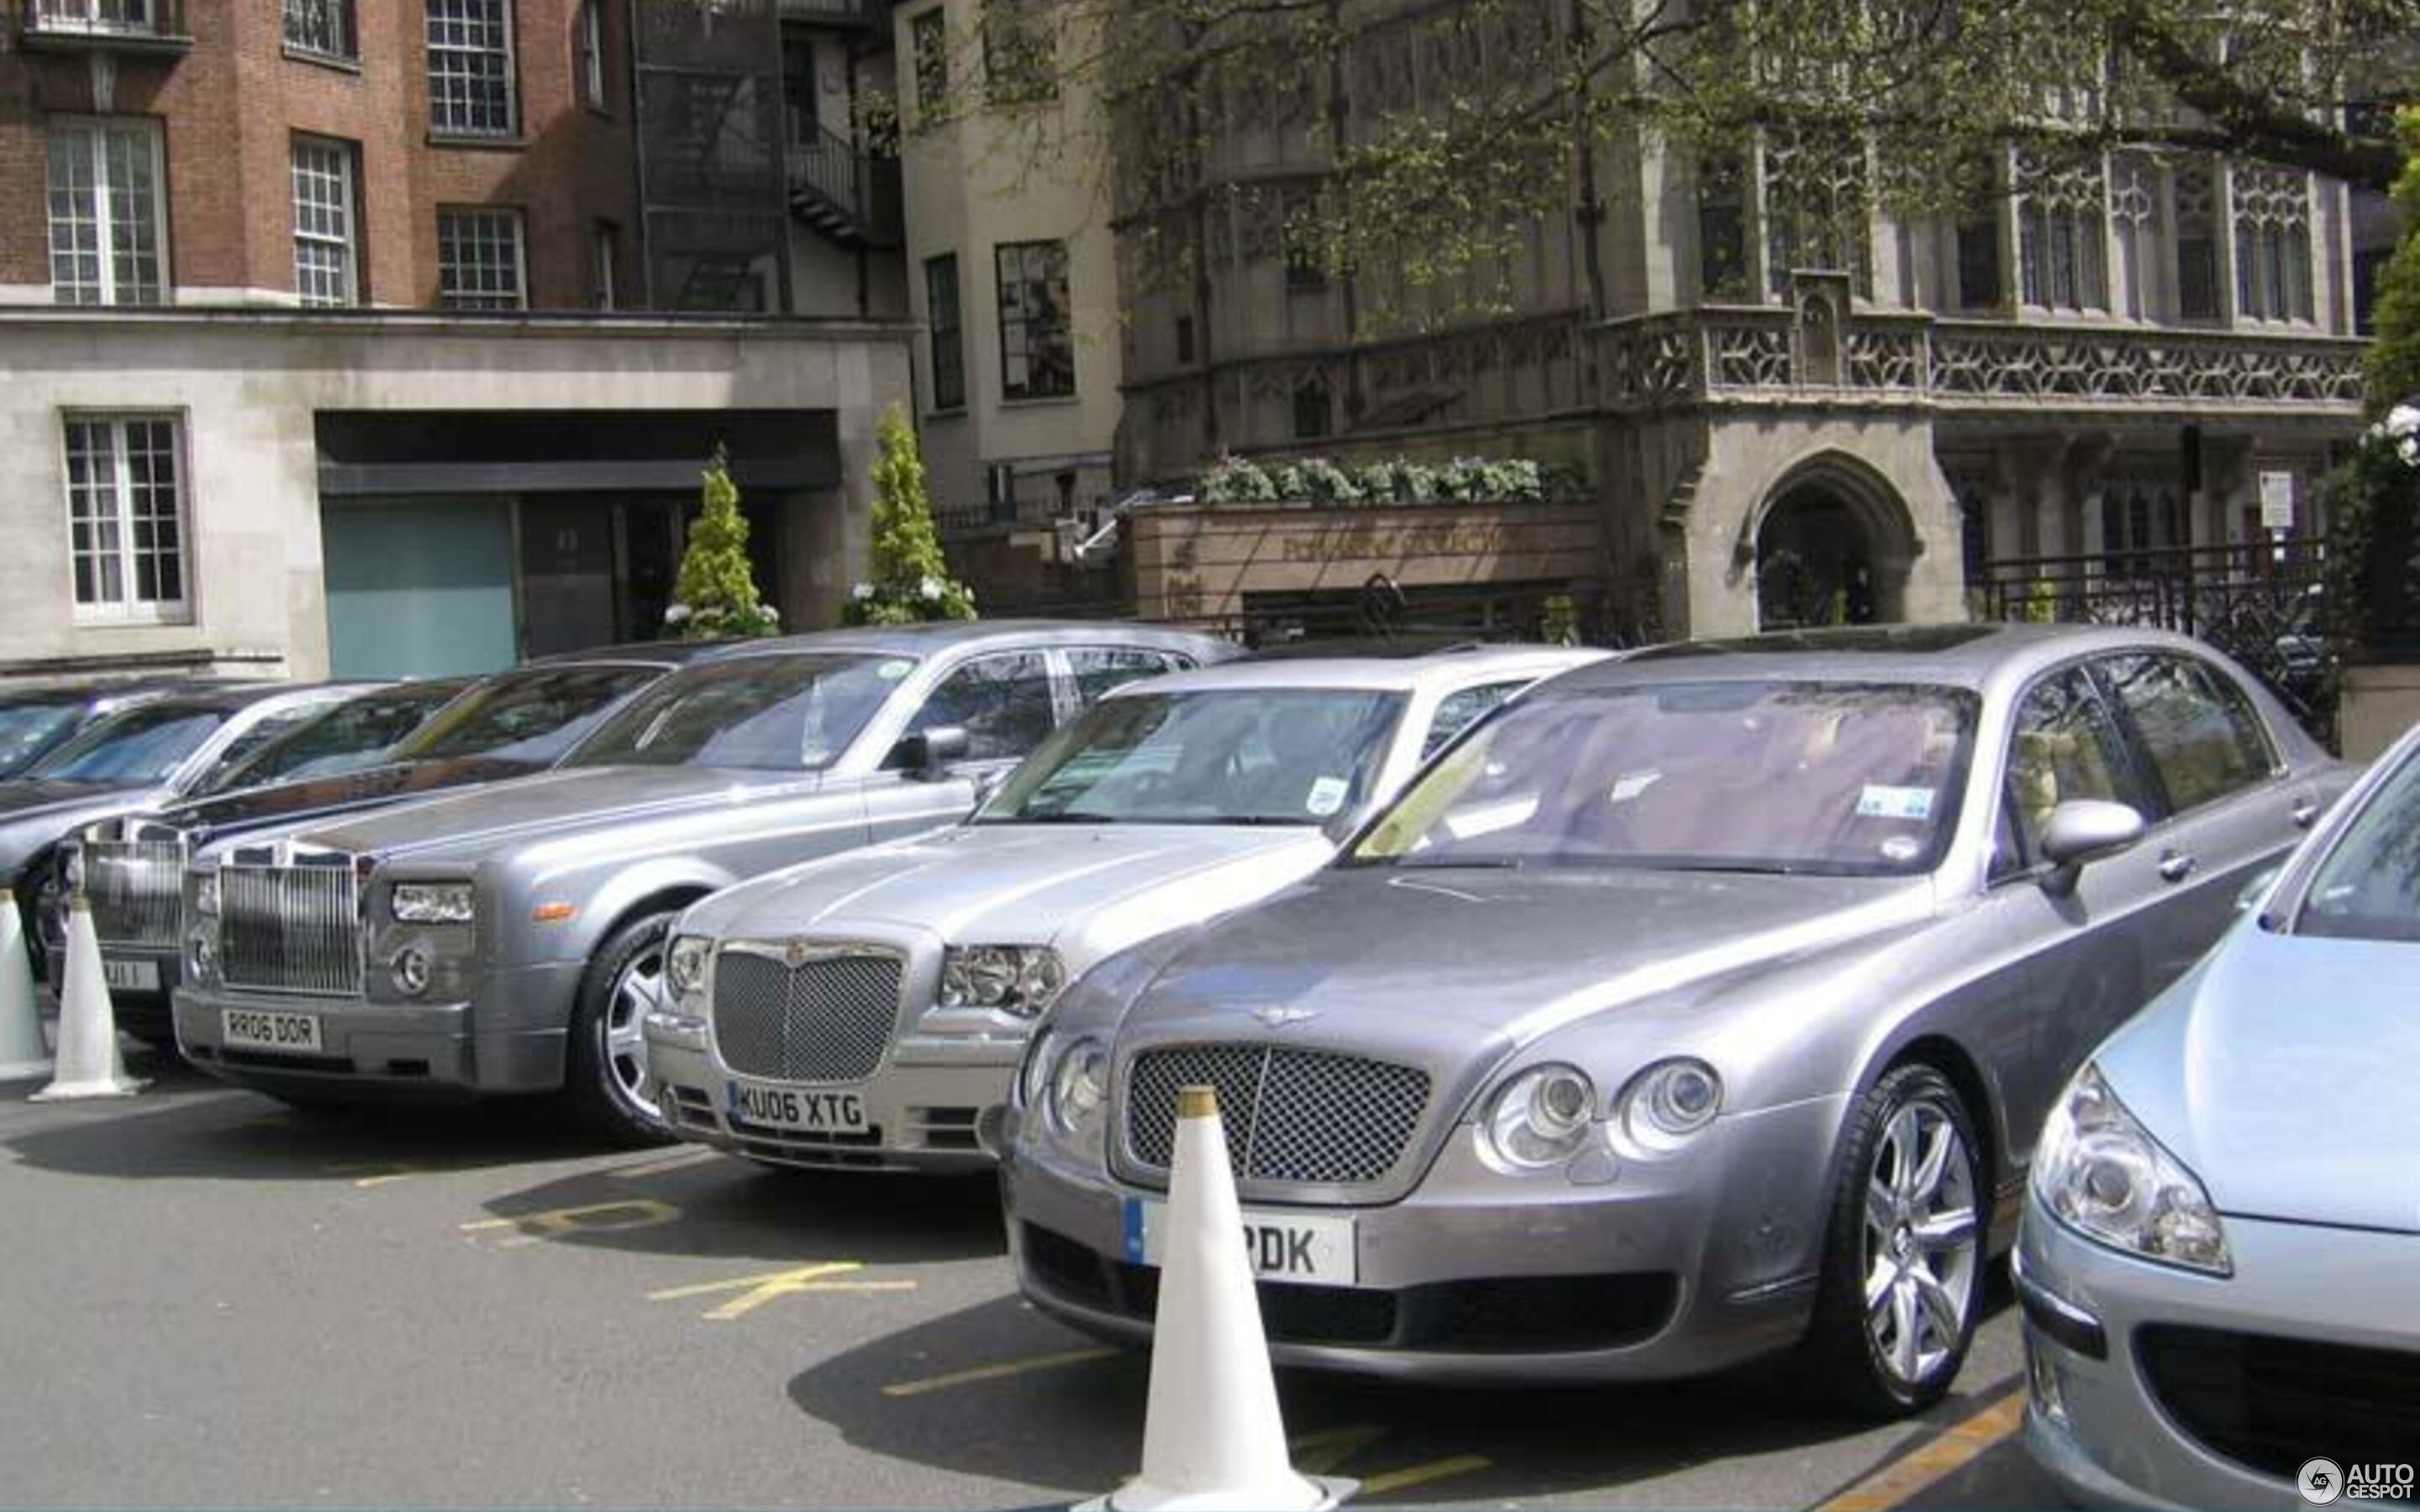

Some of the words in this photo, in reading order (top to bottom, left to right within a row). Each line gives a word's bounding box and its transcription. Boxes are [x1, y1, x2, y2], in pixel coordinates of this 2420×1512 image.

[229, 1013, 273, 1041] RR06
[276, 1015, 313, 1044] DOR
[740, 1087, 800, 1122] KU06
[804, 1093, 862, 1126] XTG
